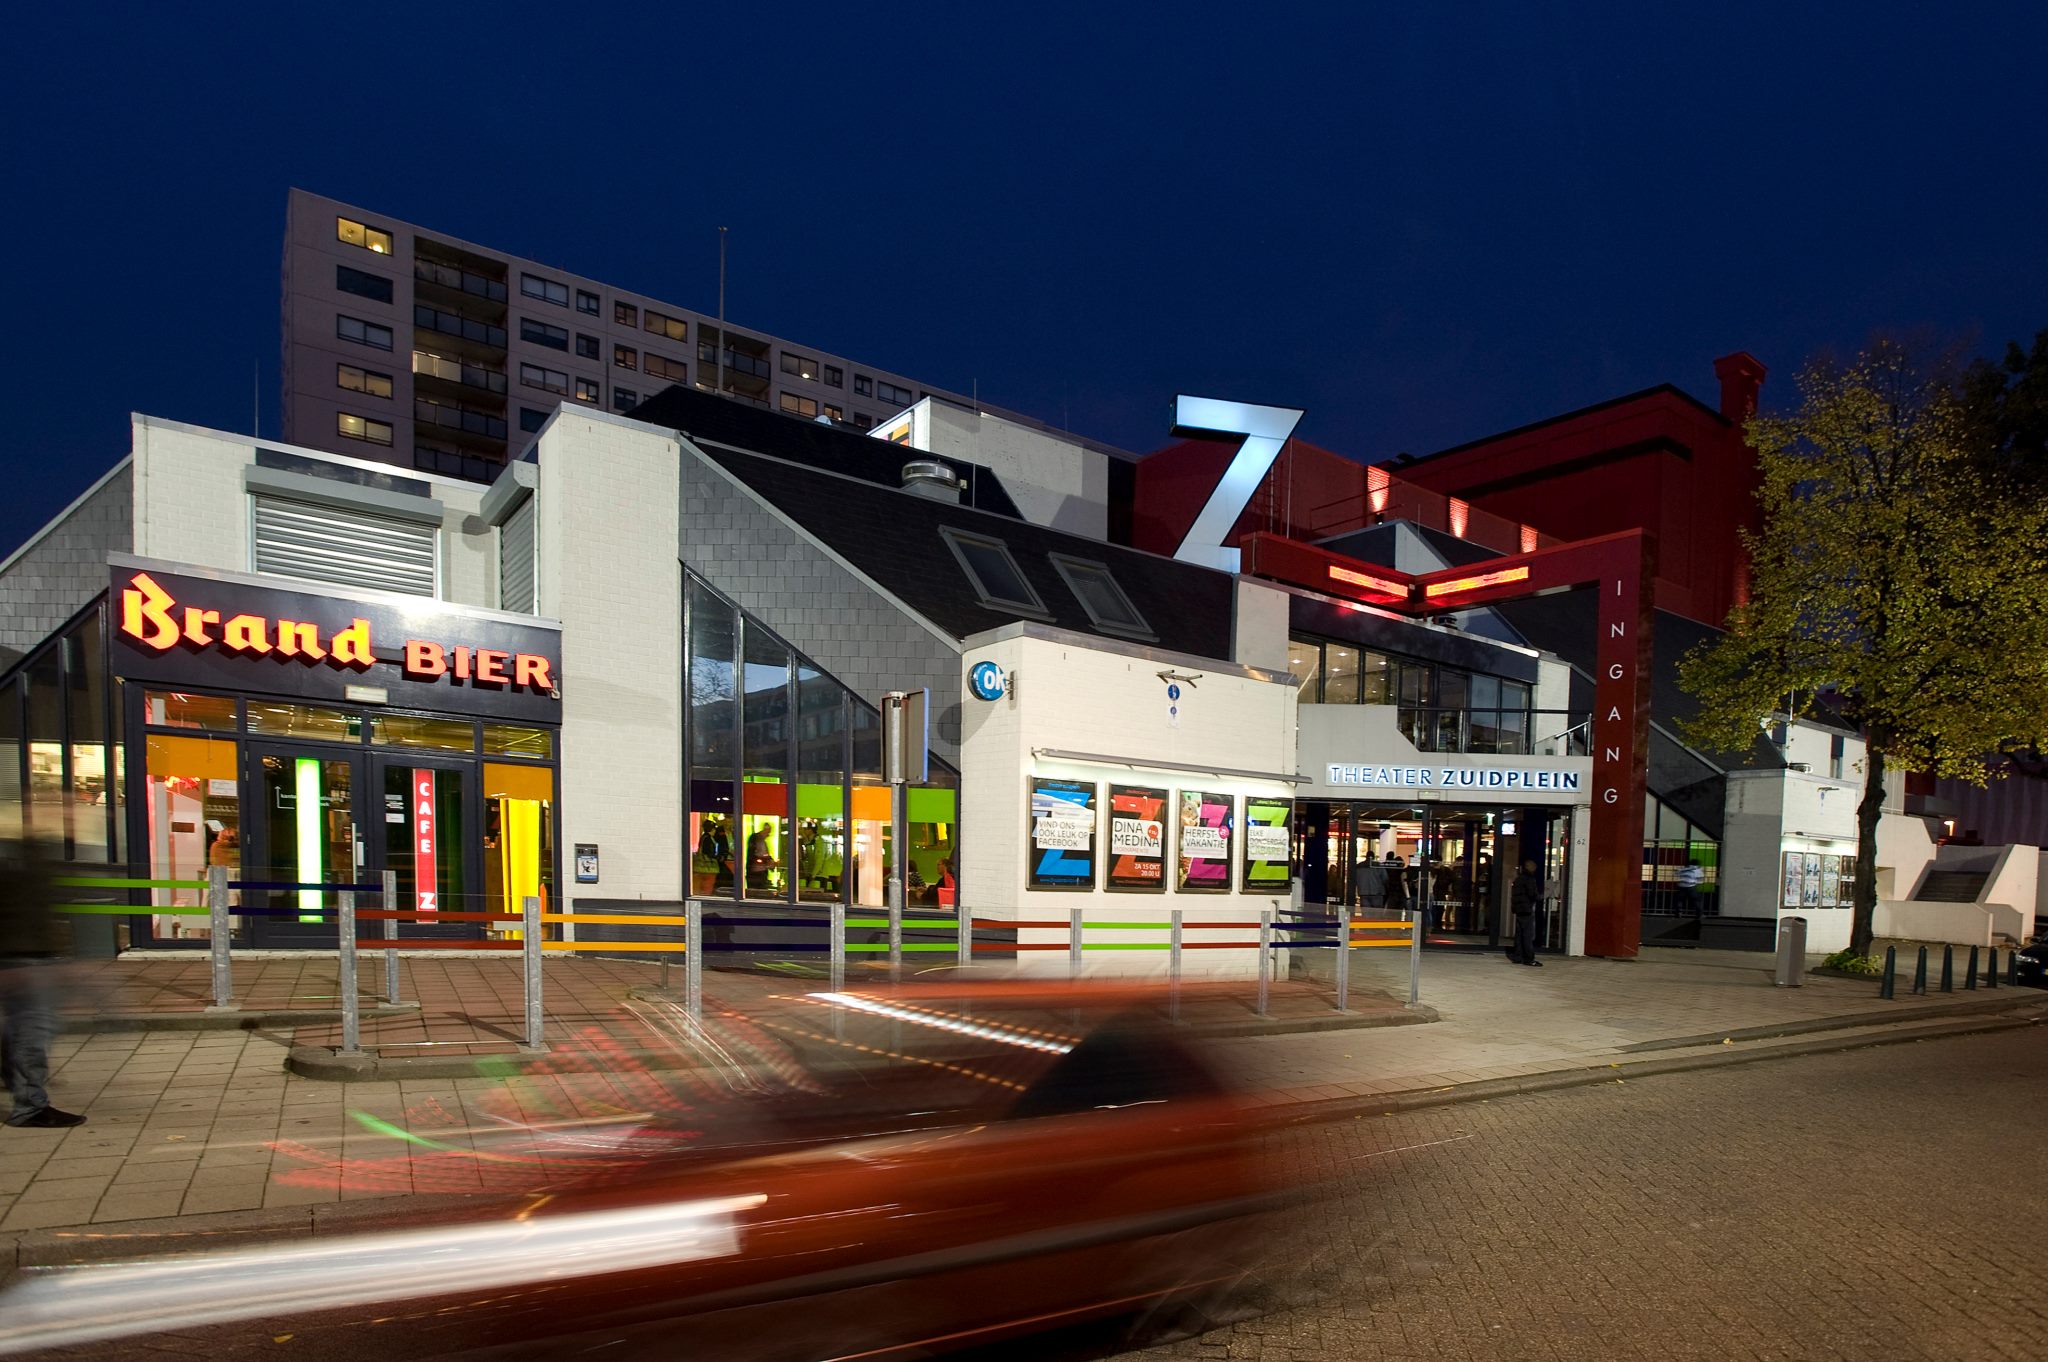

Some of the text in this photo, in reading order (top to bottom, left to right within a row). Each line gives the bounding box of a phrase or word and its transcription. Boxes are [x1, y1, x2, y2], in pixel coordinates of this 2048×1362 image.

[121, 572, 554, 689] Brand BIER
[1603, 580, 1626, 804] INGANG
[1330, 767, 1579, 789] THEATER ZUIDPLEIN
[1039, 820, 1076, 830] VIND ONS
[1114, 821, 1143, 833] DINA
[1039, 829, 1089, 839] OOK LEUK OP
[1185, 828, 1218, 839] HERFST-
[418, 781, 436, 910] CAFE Z
[1039, 838, 1078, 847] FACEBOOK
[1114, 834, 1160, 847] MEDINA
[1185, 838, 1225, 848] VAKANTIE
